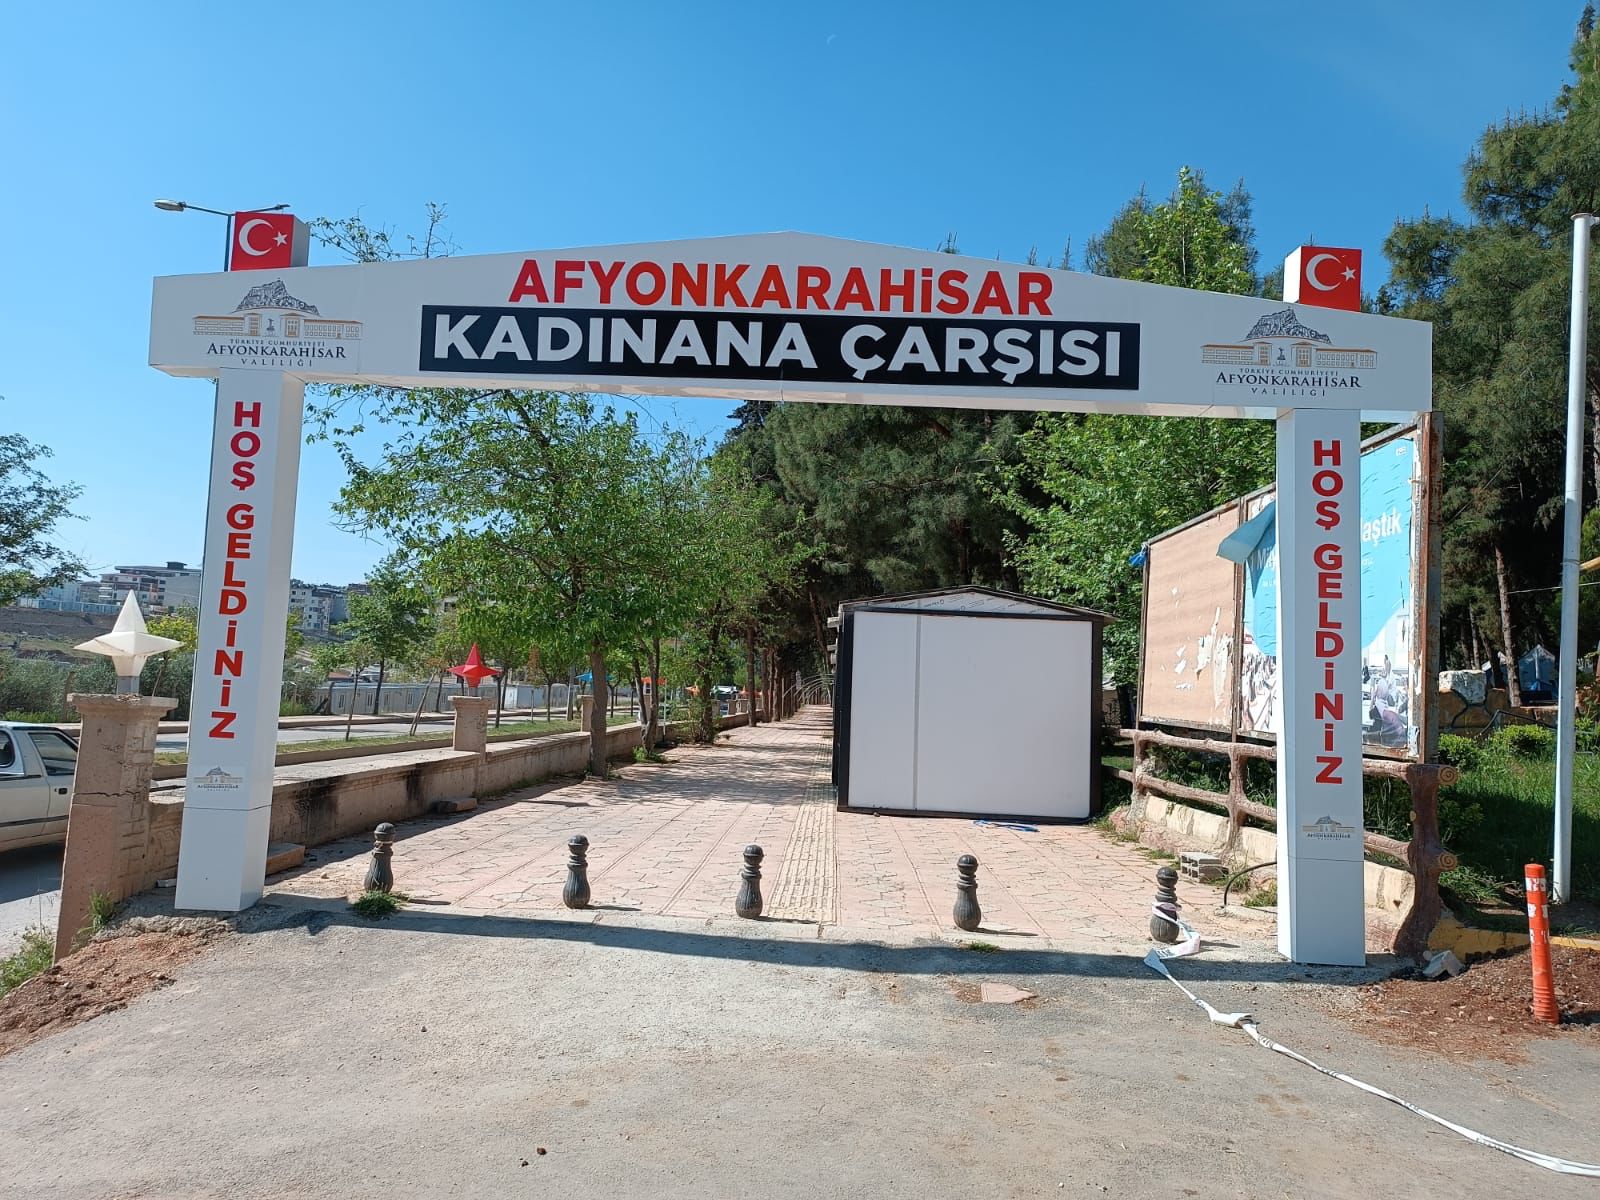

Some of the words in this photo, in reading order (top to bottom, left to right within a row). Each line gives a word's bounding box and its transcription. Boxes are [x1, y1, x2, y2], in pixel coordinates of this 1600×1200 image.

[434, 314, 818, 369] KADINANA
[840, 324, 1121, 385] ÇARŞISI
[230, 402, 262, 490] HOŞ
[1312, 439, 1344, 530] HOŞ
[1361, 506, 1402, 547] aştık
